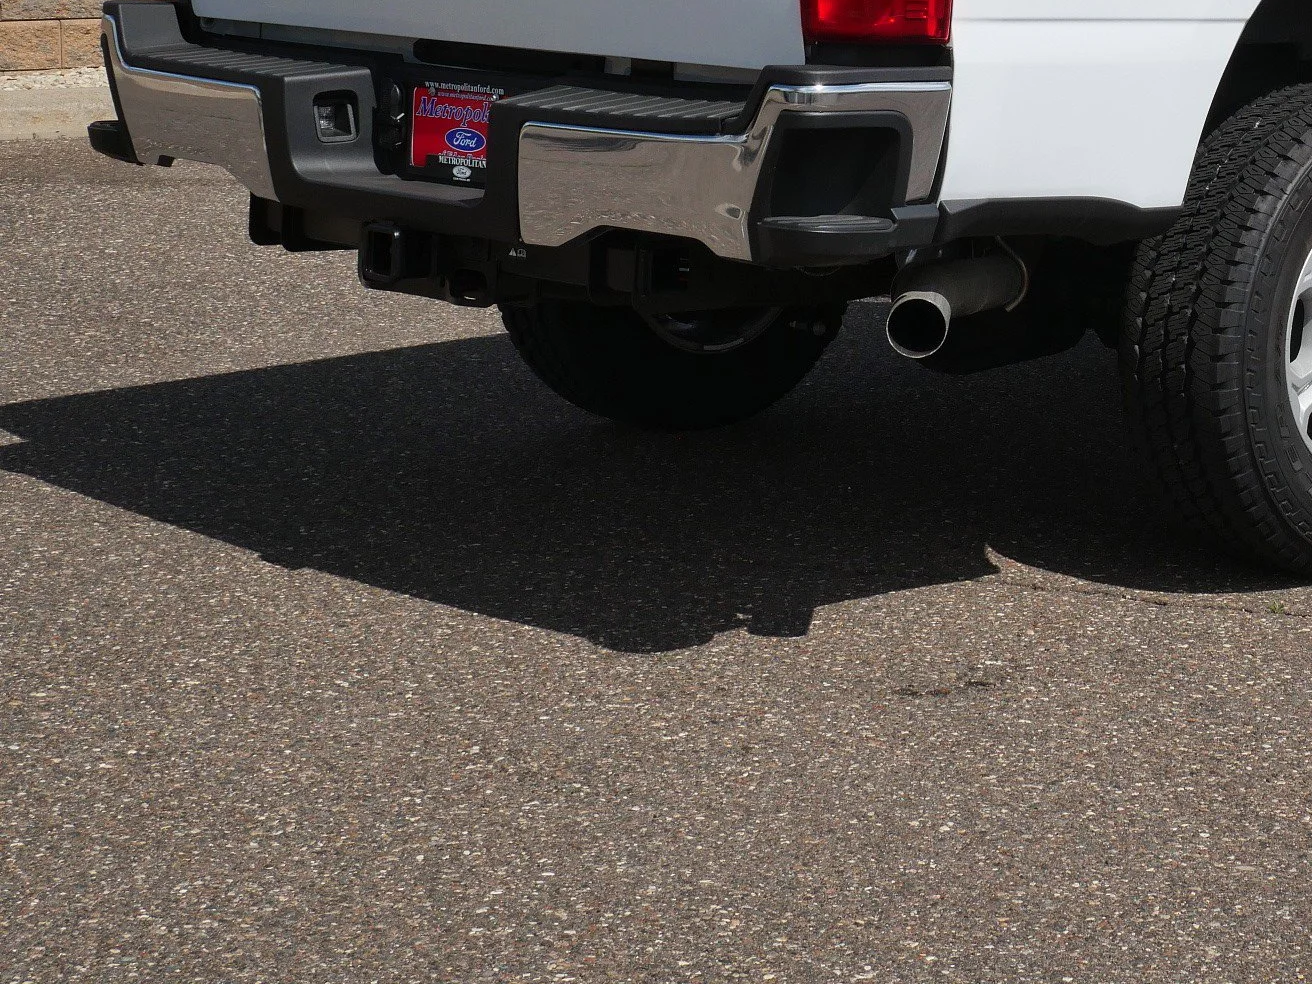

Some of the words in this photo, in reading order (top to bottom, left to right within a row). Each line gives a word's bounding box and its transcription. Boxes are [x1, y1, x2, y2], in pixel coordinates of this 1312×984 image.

[424, 80, 505, 96] www.metropolitanford.com
[453, 131, 478, 148] Ford
[438, 155, 487, 168] METROPOLITAN
